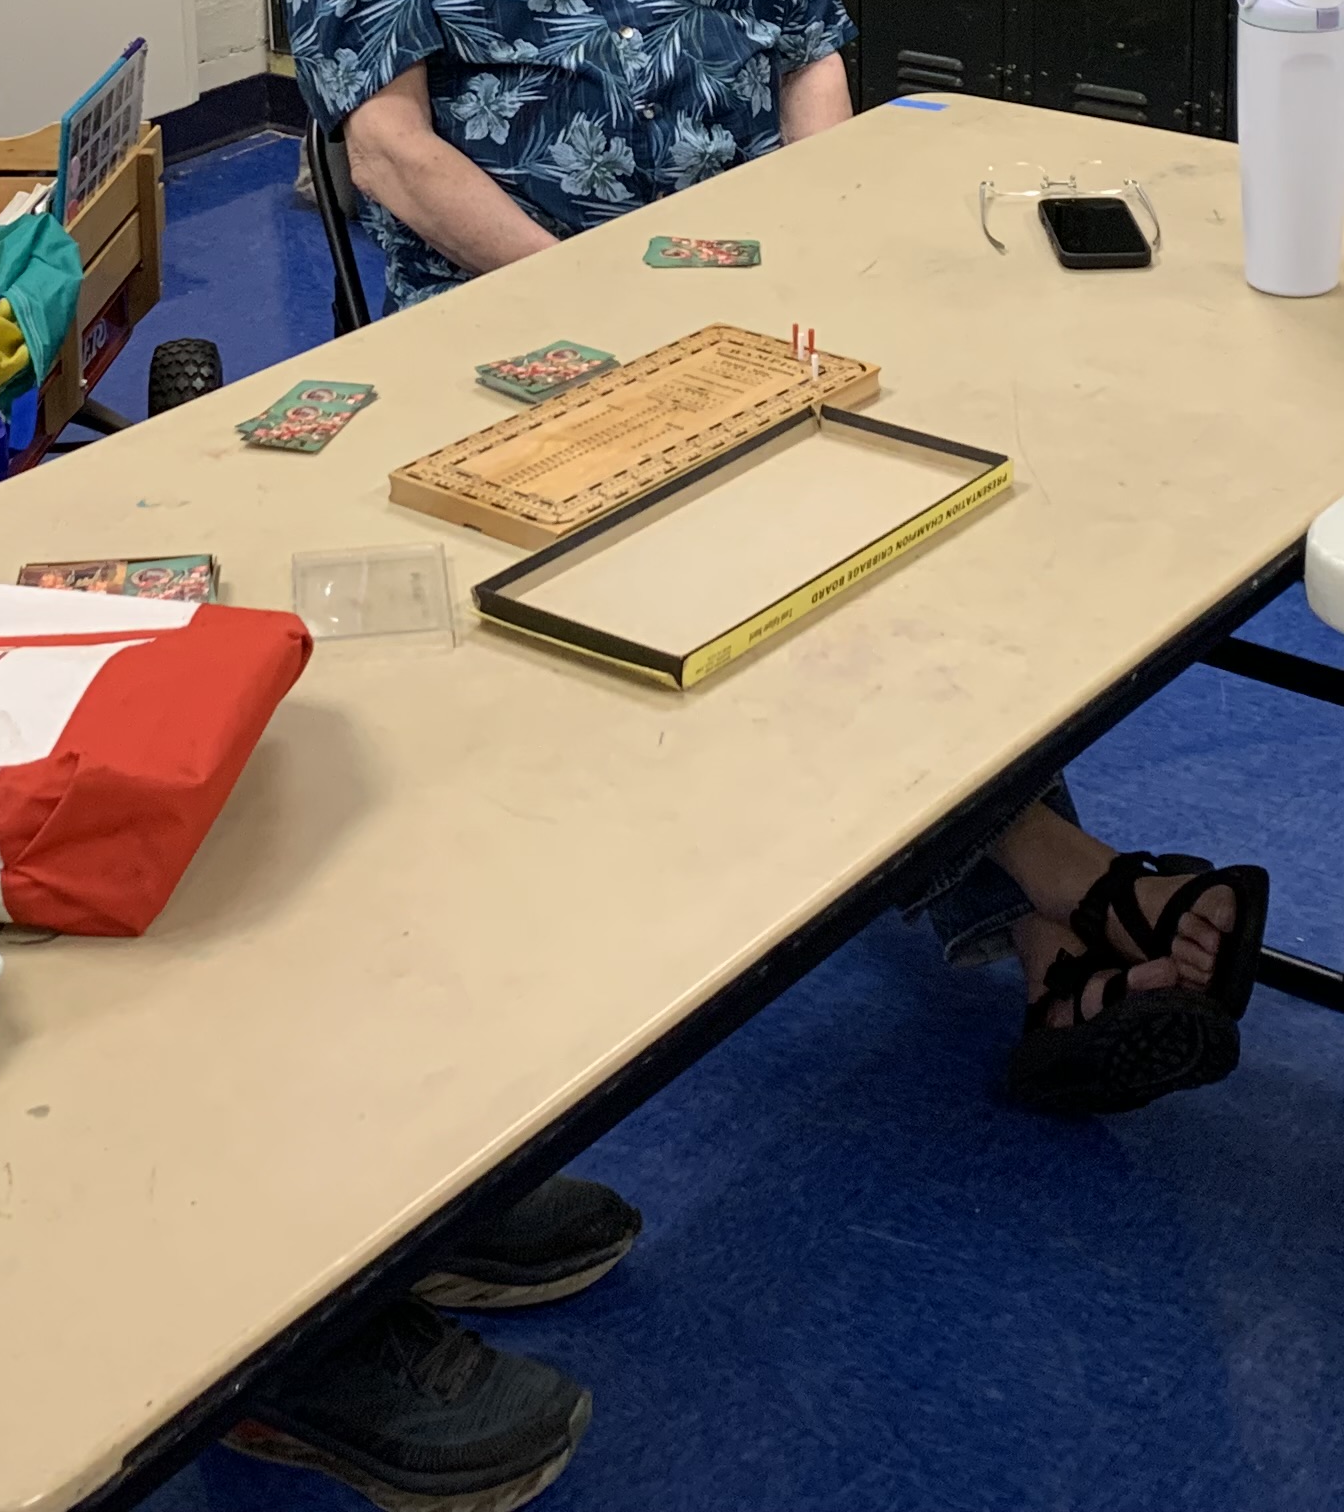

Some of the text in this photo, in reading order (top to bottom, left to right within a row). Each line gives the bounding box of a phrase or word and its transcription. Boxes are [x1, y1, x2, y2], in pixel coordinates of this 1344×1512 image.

[811, 472, 1008, 604] PRESENTATION CHAMPION CRIBBAGE BOARD
